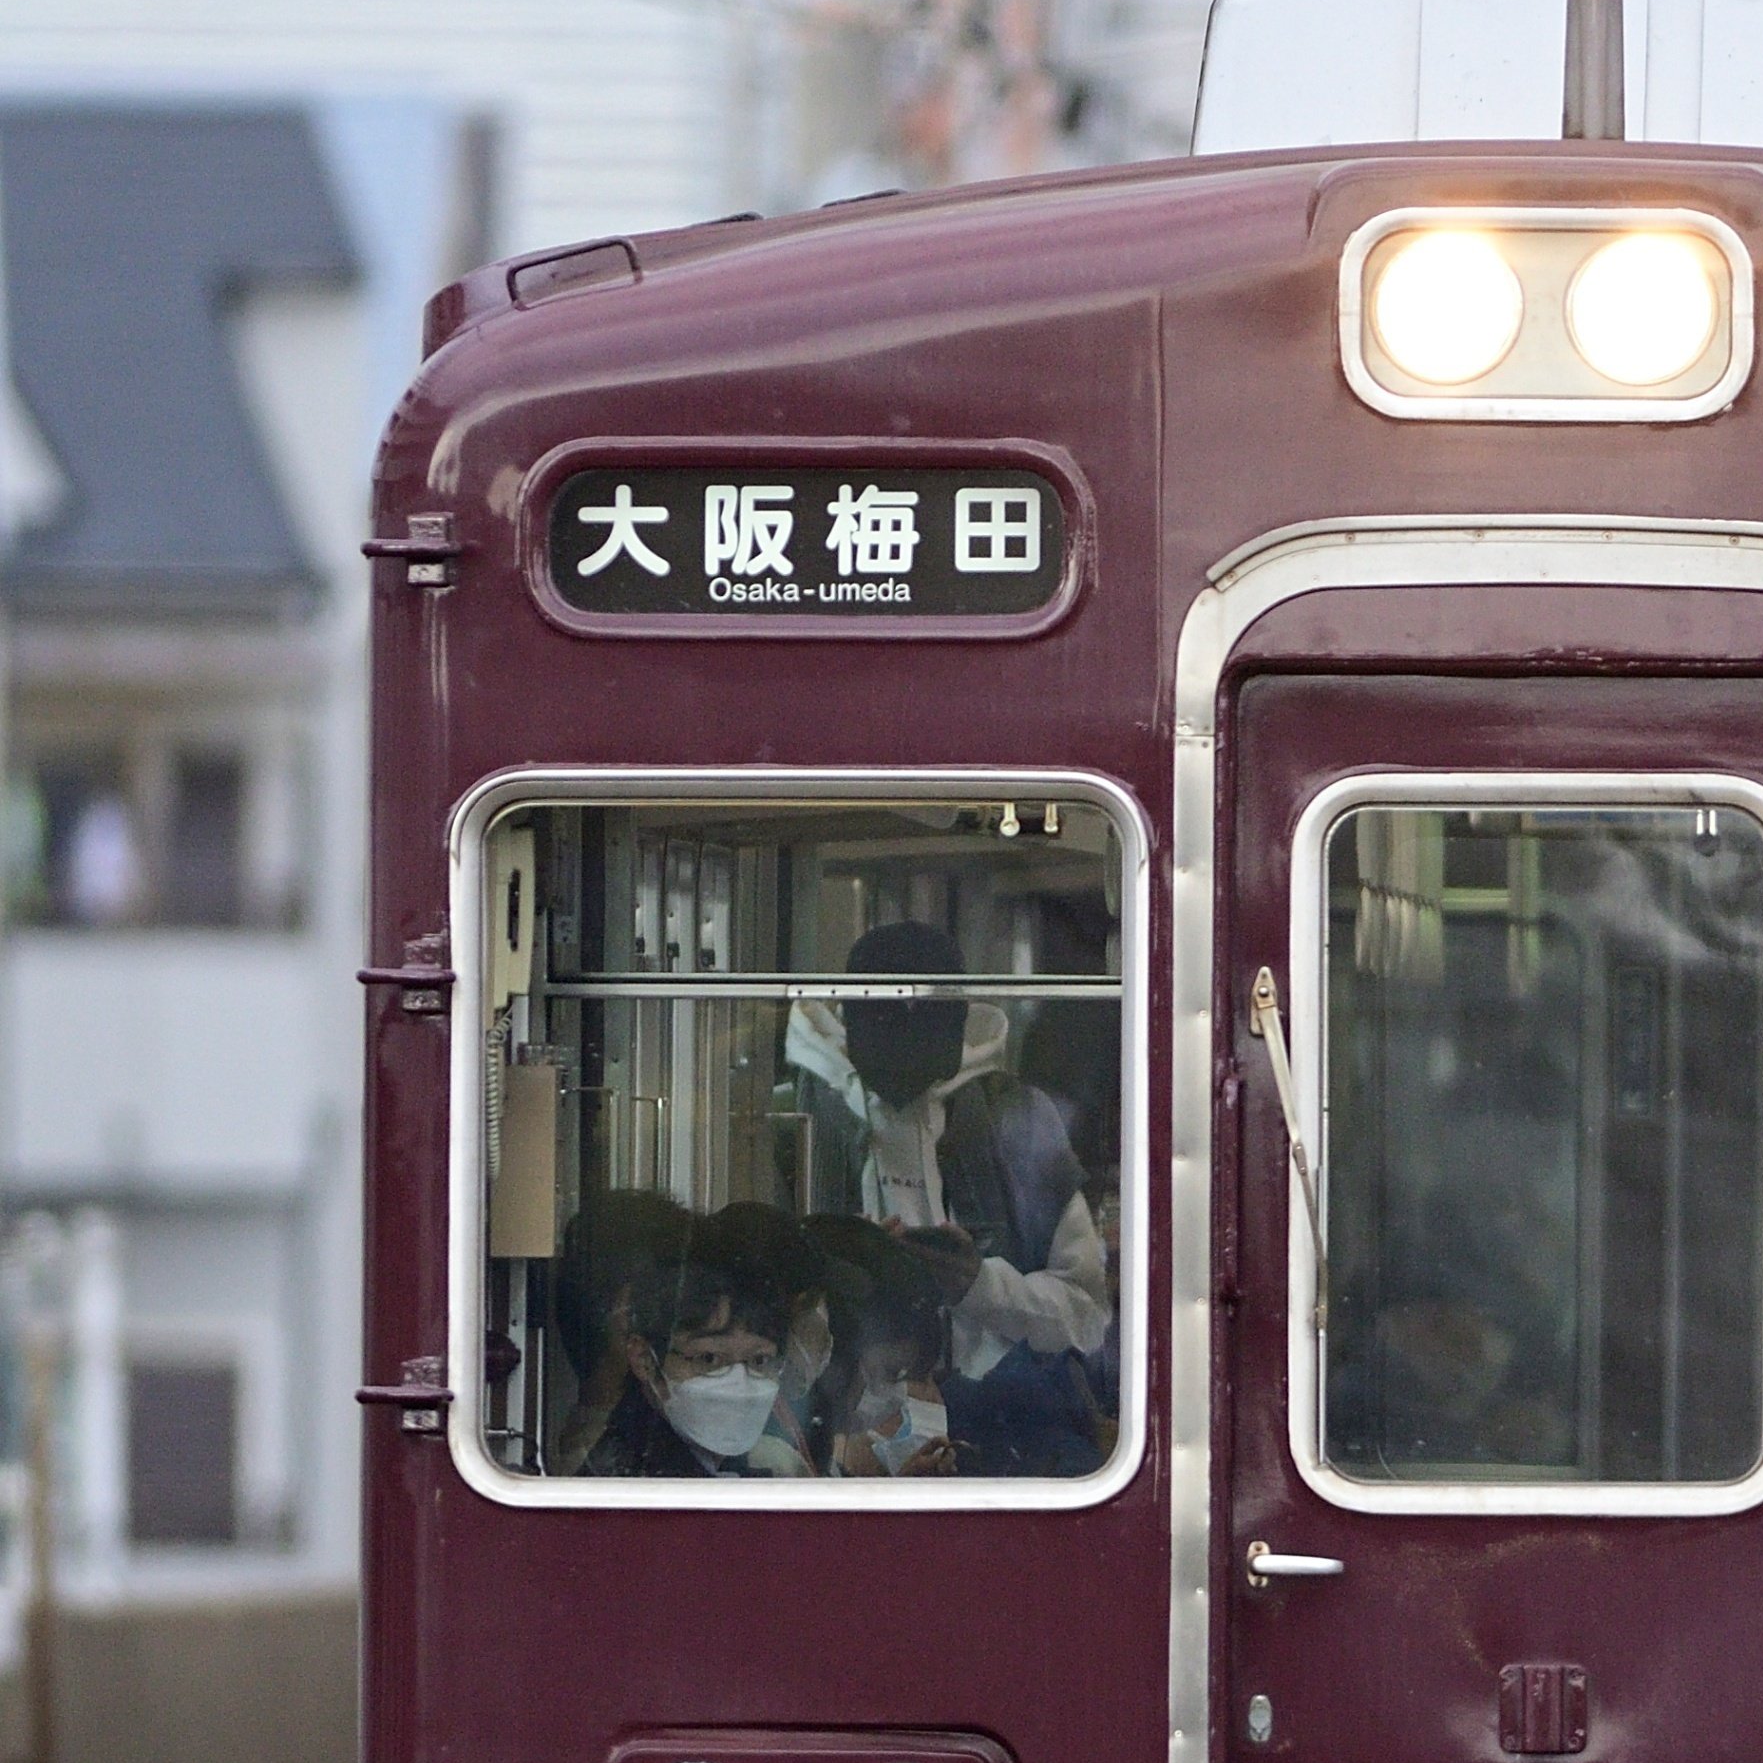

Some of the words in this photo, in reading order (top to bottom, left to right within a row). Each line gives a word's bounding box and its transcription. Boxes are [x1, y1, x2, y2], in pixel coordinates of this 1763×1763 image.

[577, 484, 1041, 576] 大阪梅田
[708, 577, 911, 602] Osaka-umeda
